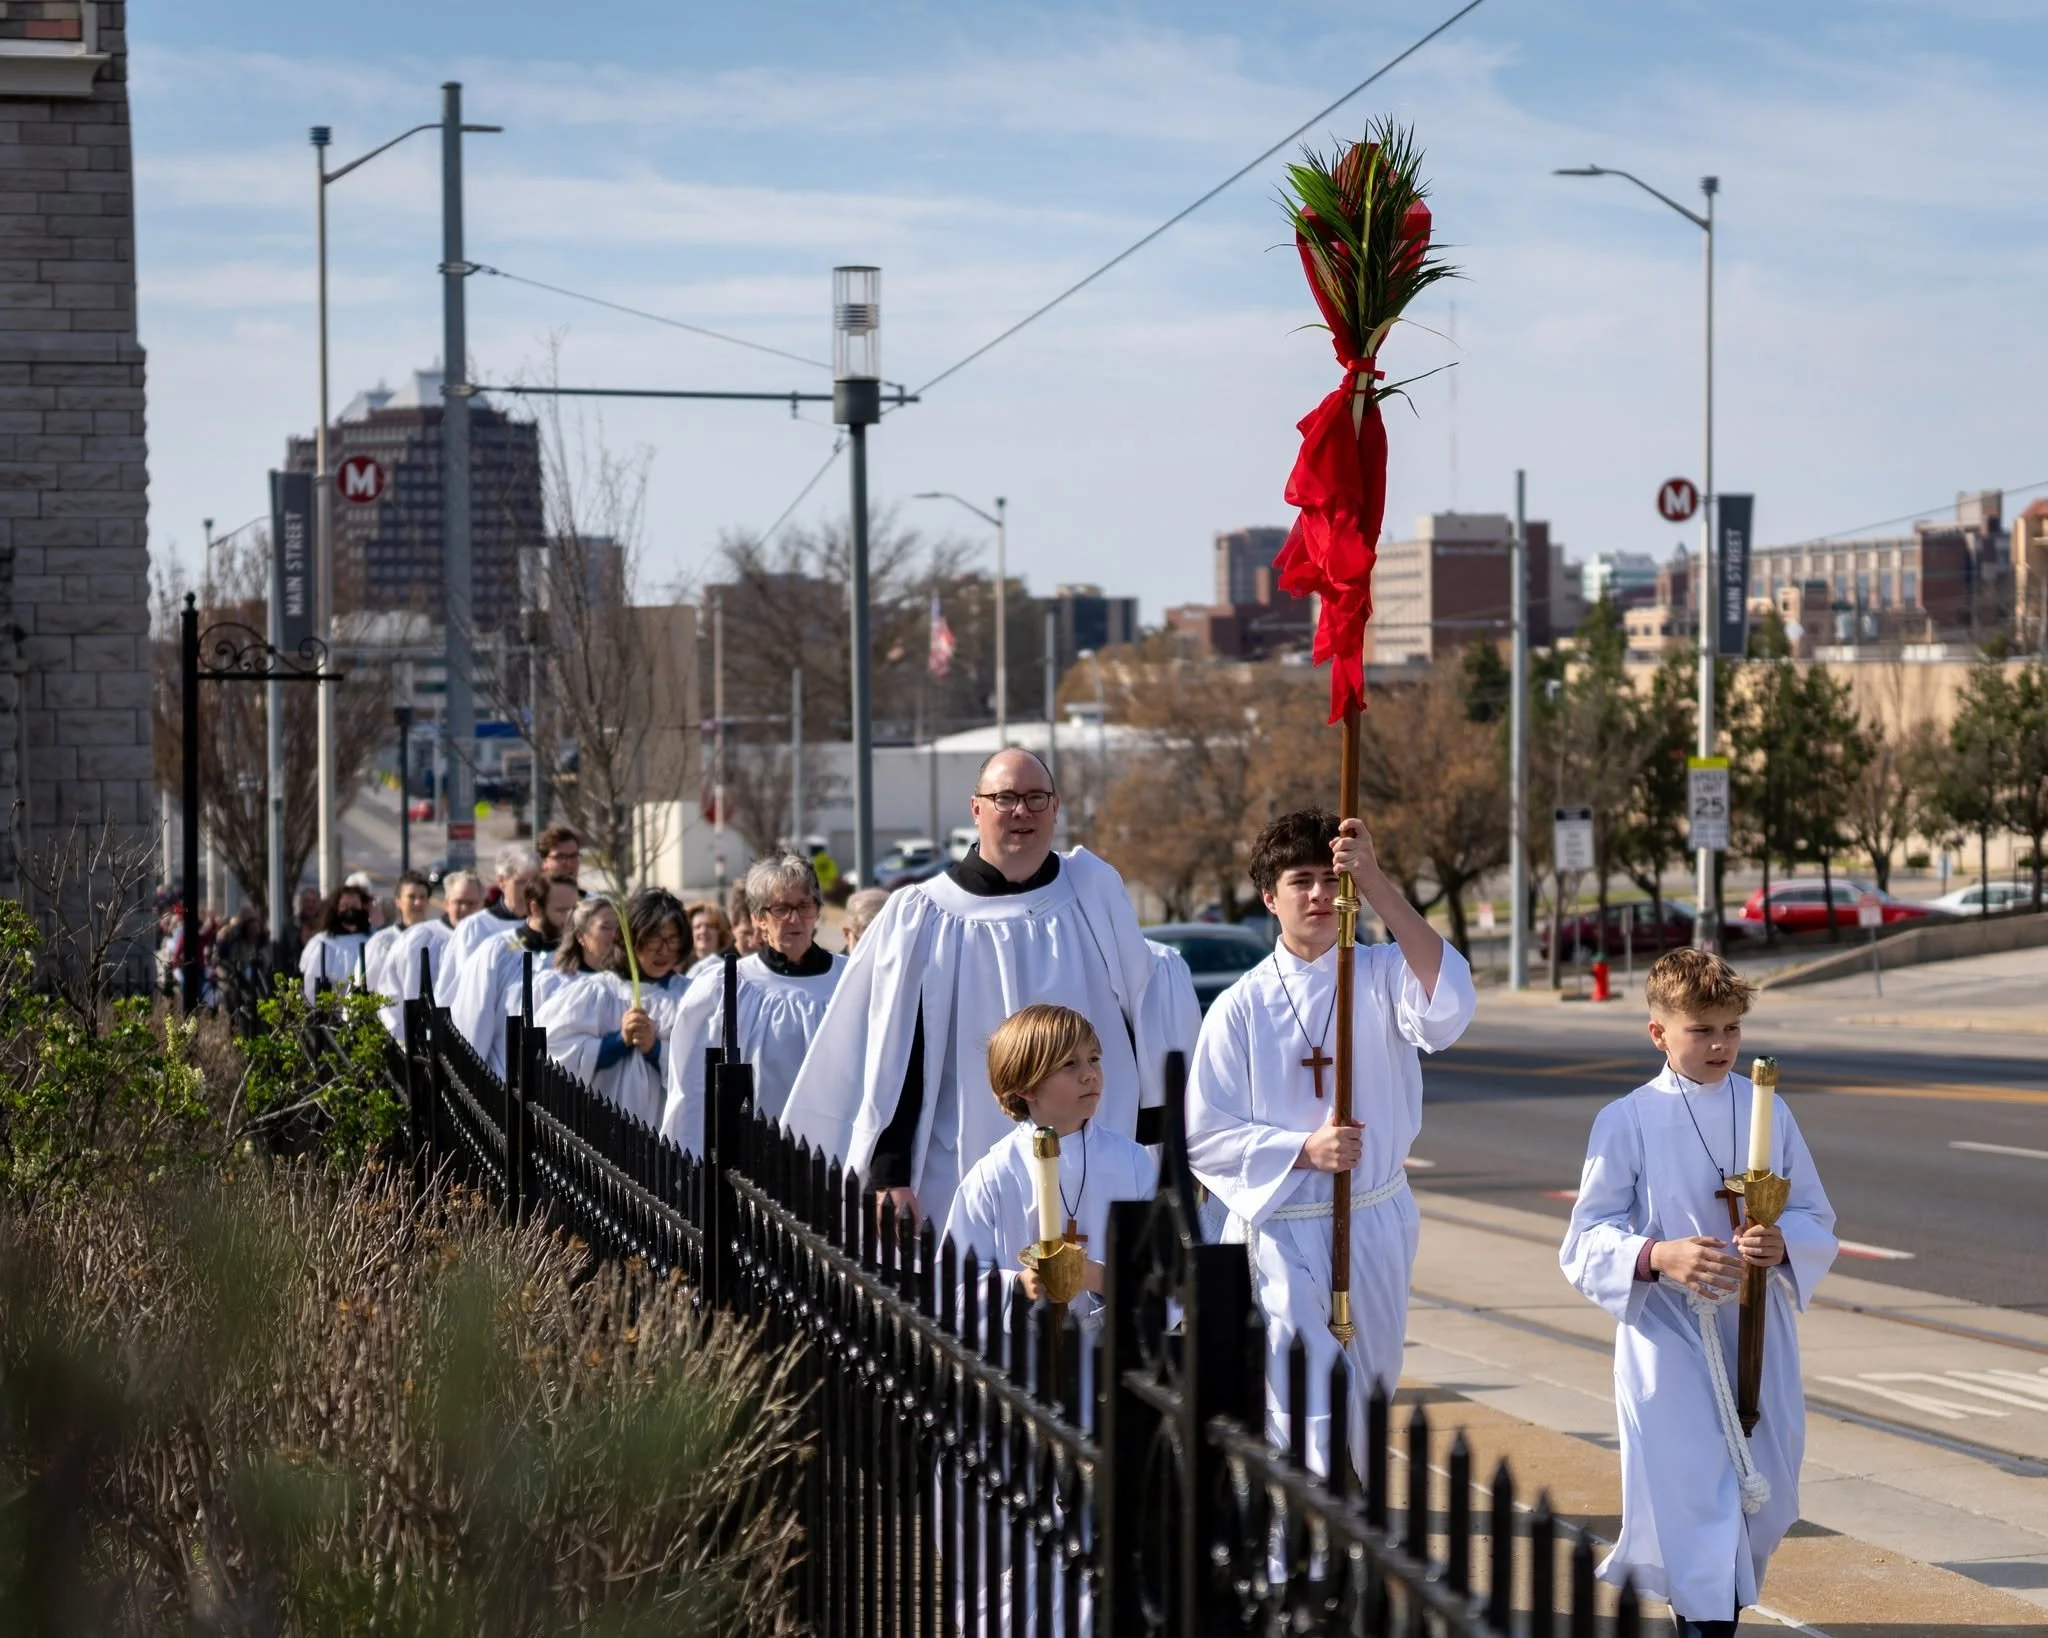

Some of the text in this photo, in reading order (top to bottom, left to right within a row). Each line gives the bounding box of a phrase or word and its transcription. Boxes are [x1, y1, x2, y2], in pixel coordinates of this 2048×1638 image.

[346, 463, 376, 496] M
[1664, 485, 1691, 515] M
[285, 511, 303, 616] MAIN STREET
[1726, 528, 1742, 624] MAIN STREET
[1695, 797, 1725, 819] 25
